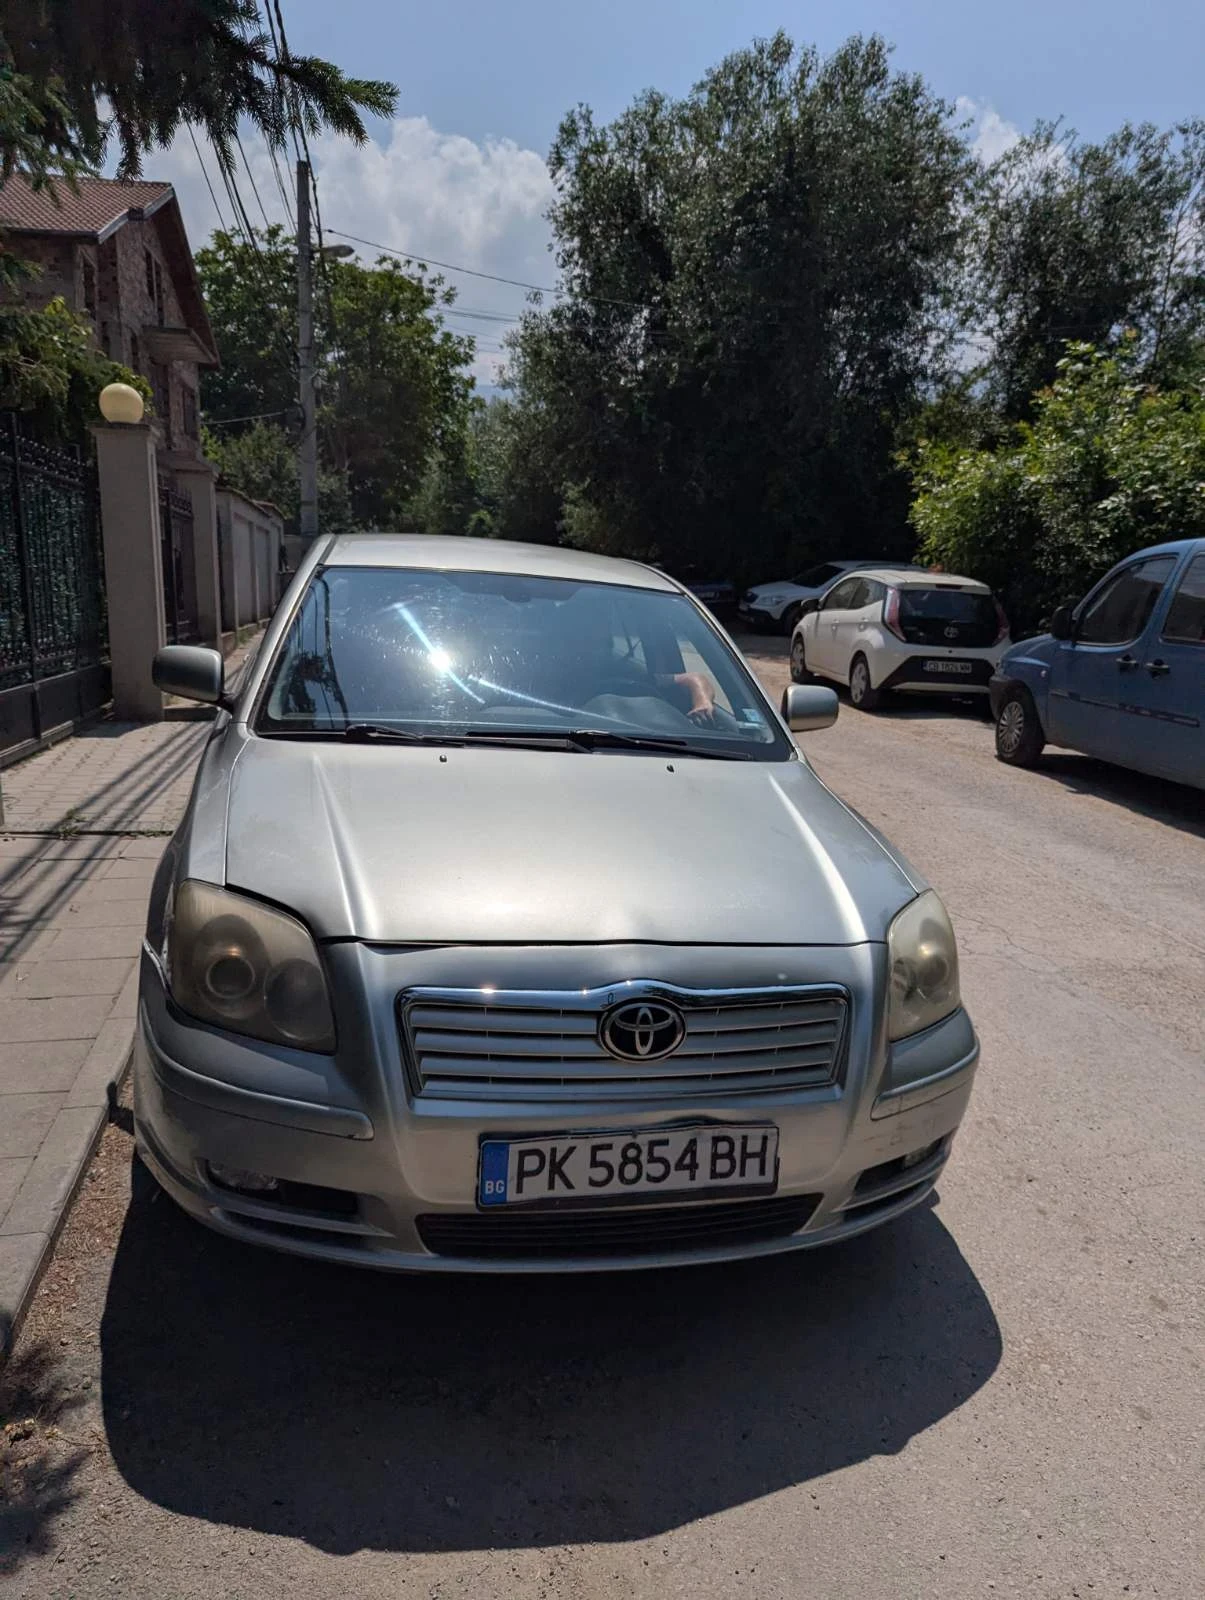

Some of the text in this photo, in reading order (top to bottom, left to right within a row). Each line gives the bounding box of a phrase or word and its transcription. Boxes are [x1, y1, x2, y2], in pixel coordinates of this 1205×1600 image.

[515, 1134, 769, 1194] PK 5854 BH
[484, 1180, 505, 1194] BG
